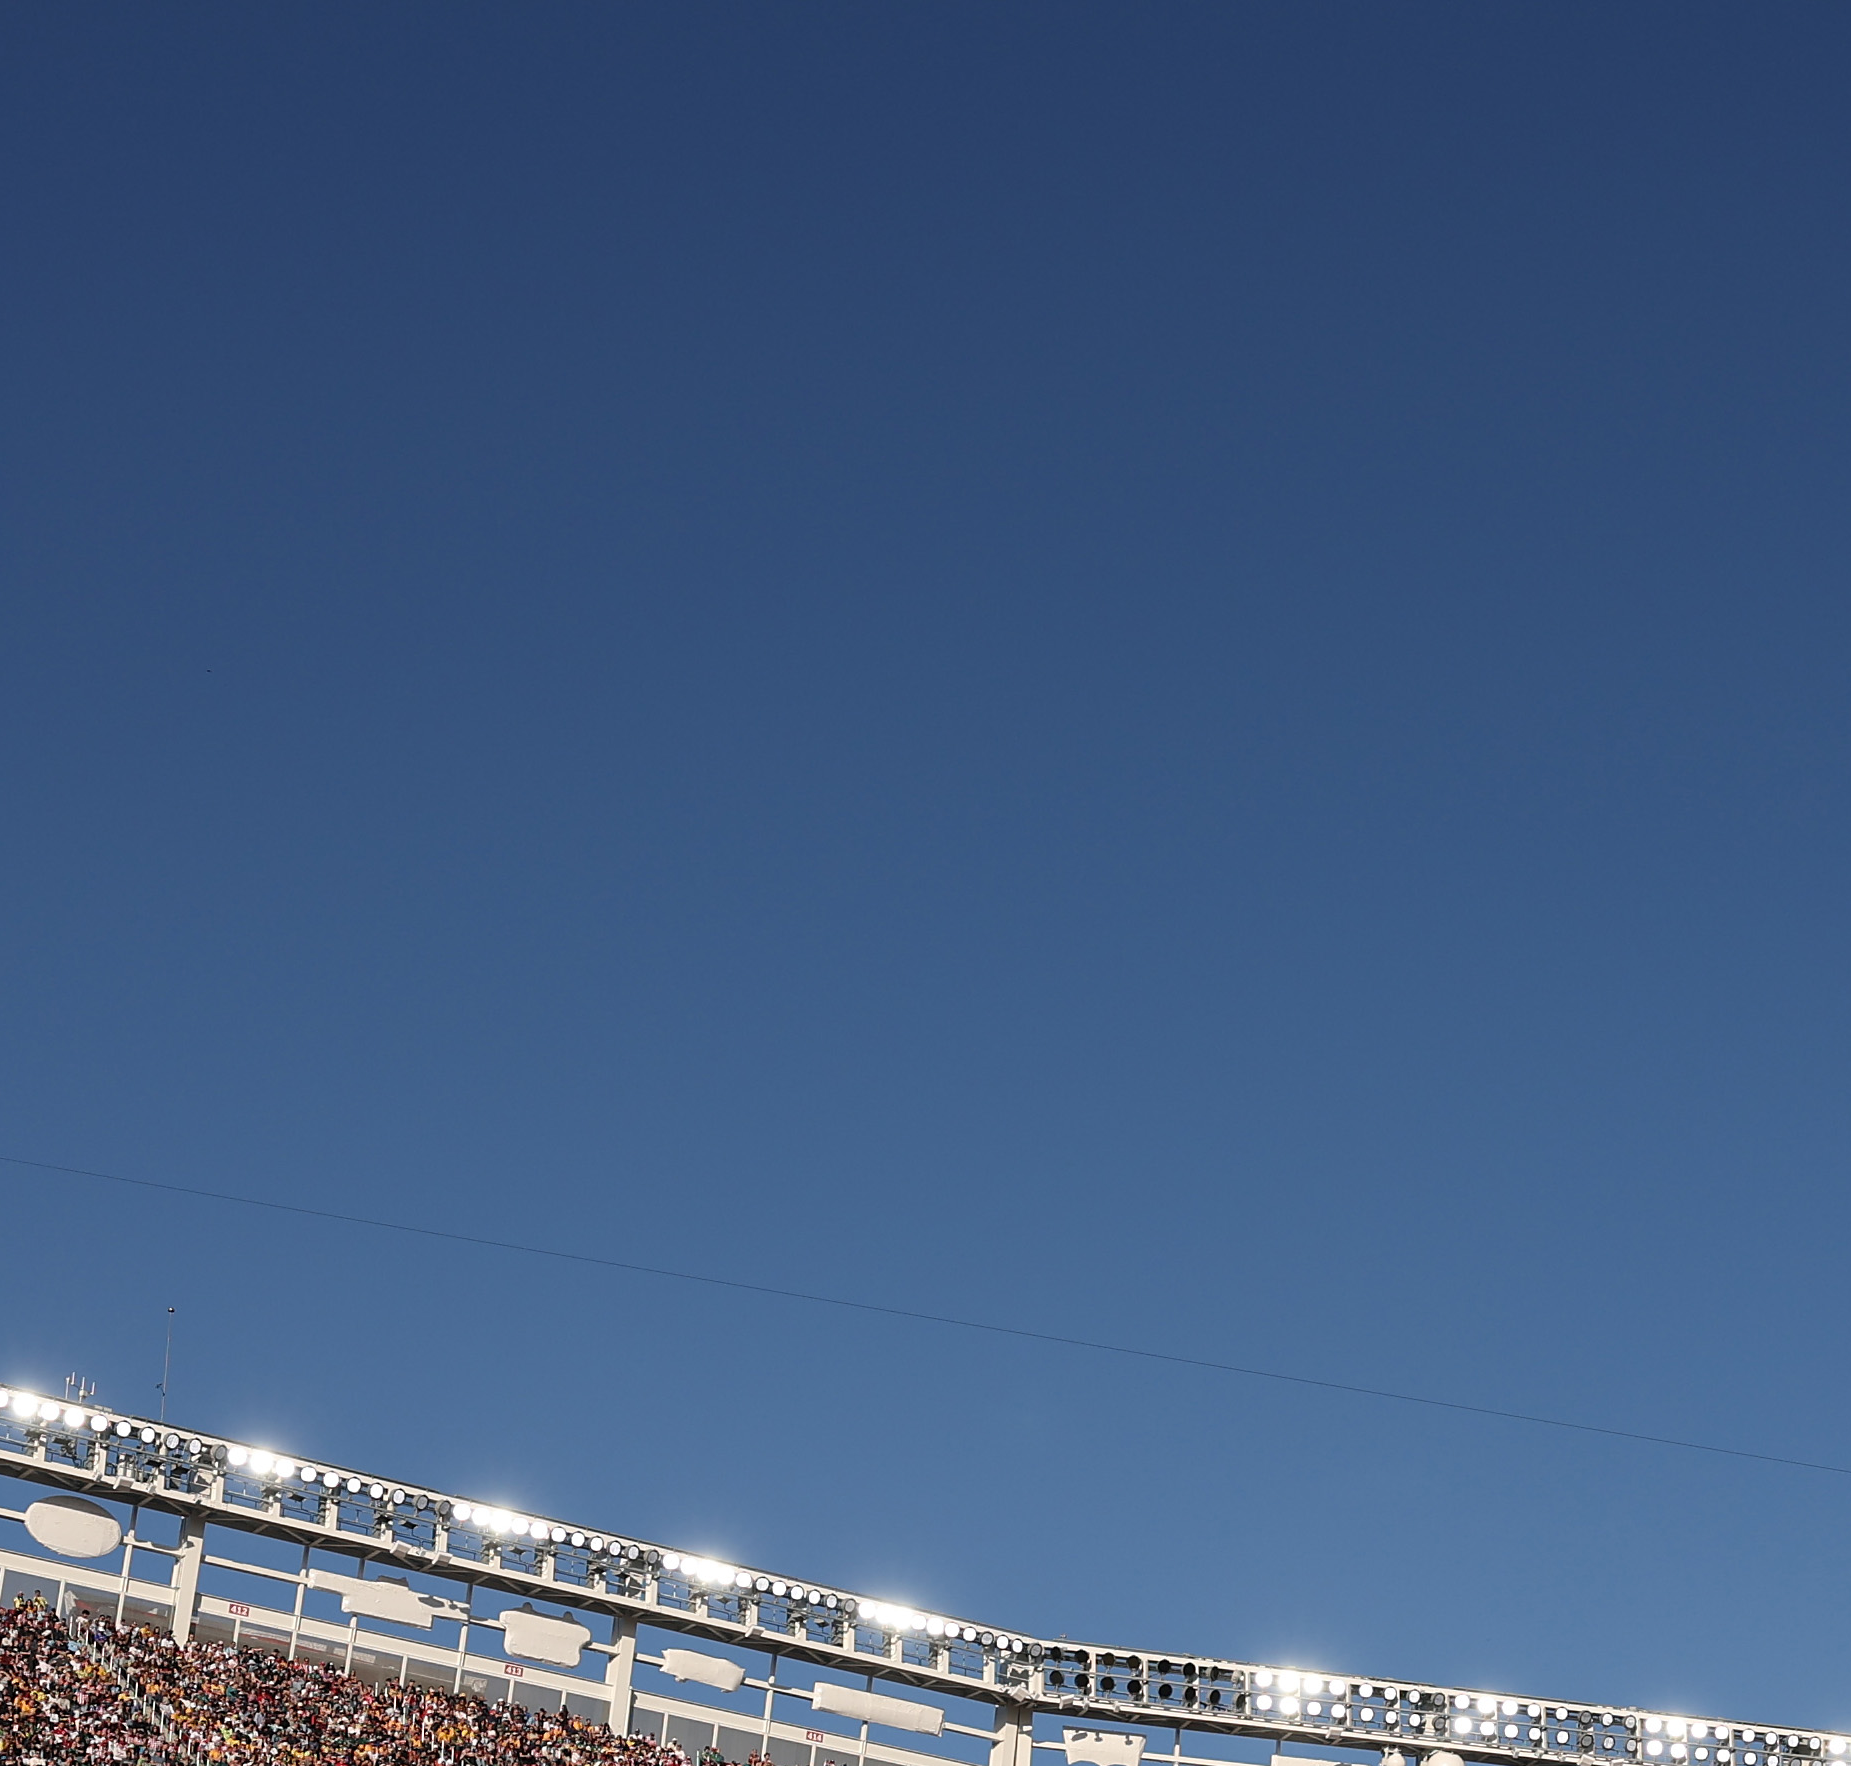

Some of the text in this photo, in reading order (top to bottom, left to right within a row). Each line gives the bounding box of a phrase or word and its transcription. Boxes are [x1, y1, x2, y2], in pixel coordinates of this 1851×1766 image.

[231, 1606, 248, 1615] 412
[506, 1666, 522, 1675] 413
[807, 1732, 822, 1742] 414
